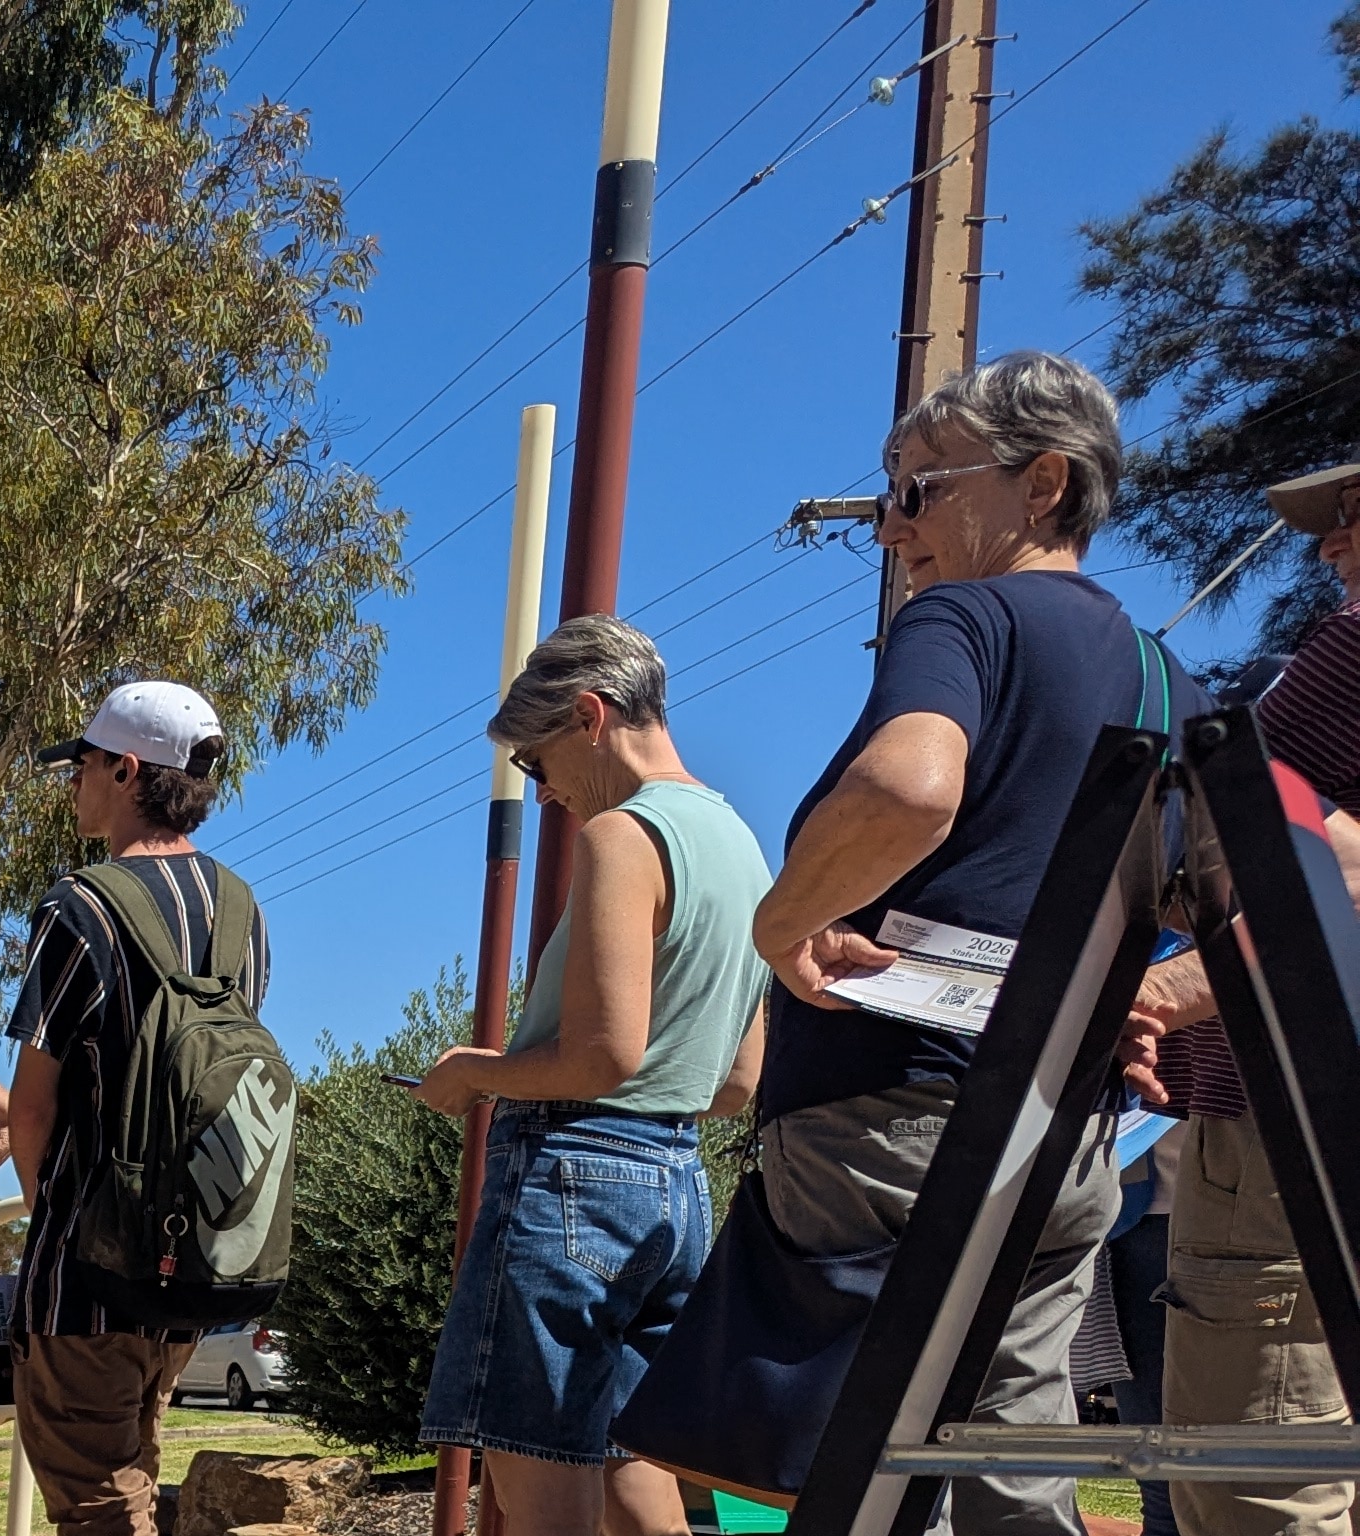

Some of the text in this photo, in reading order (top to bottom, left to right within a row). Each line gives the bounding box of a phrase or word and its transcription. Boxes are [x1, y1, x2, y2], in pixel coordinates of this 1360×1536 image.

[950, 948, 1009, 964] State Electio
[966, 937, 1014, 956] 2026
[187, 1058, 289, 1221] NIKE
